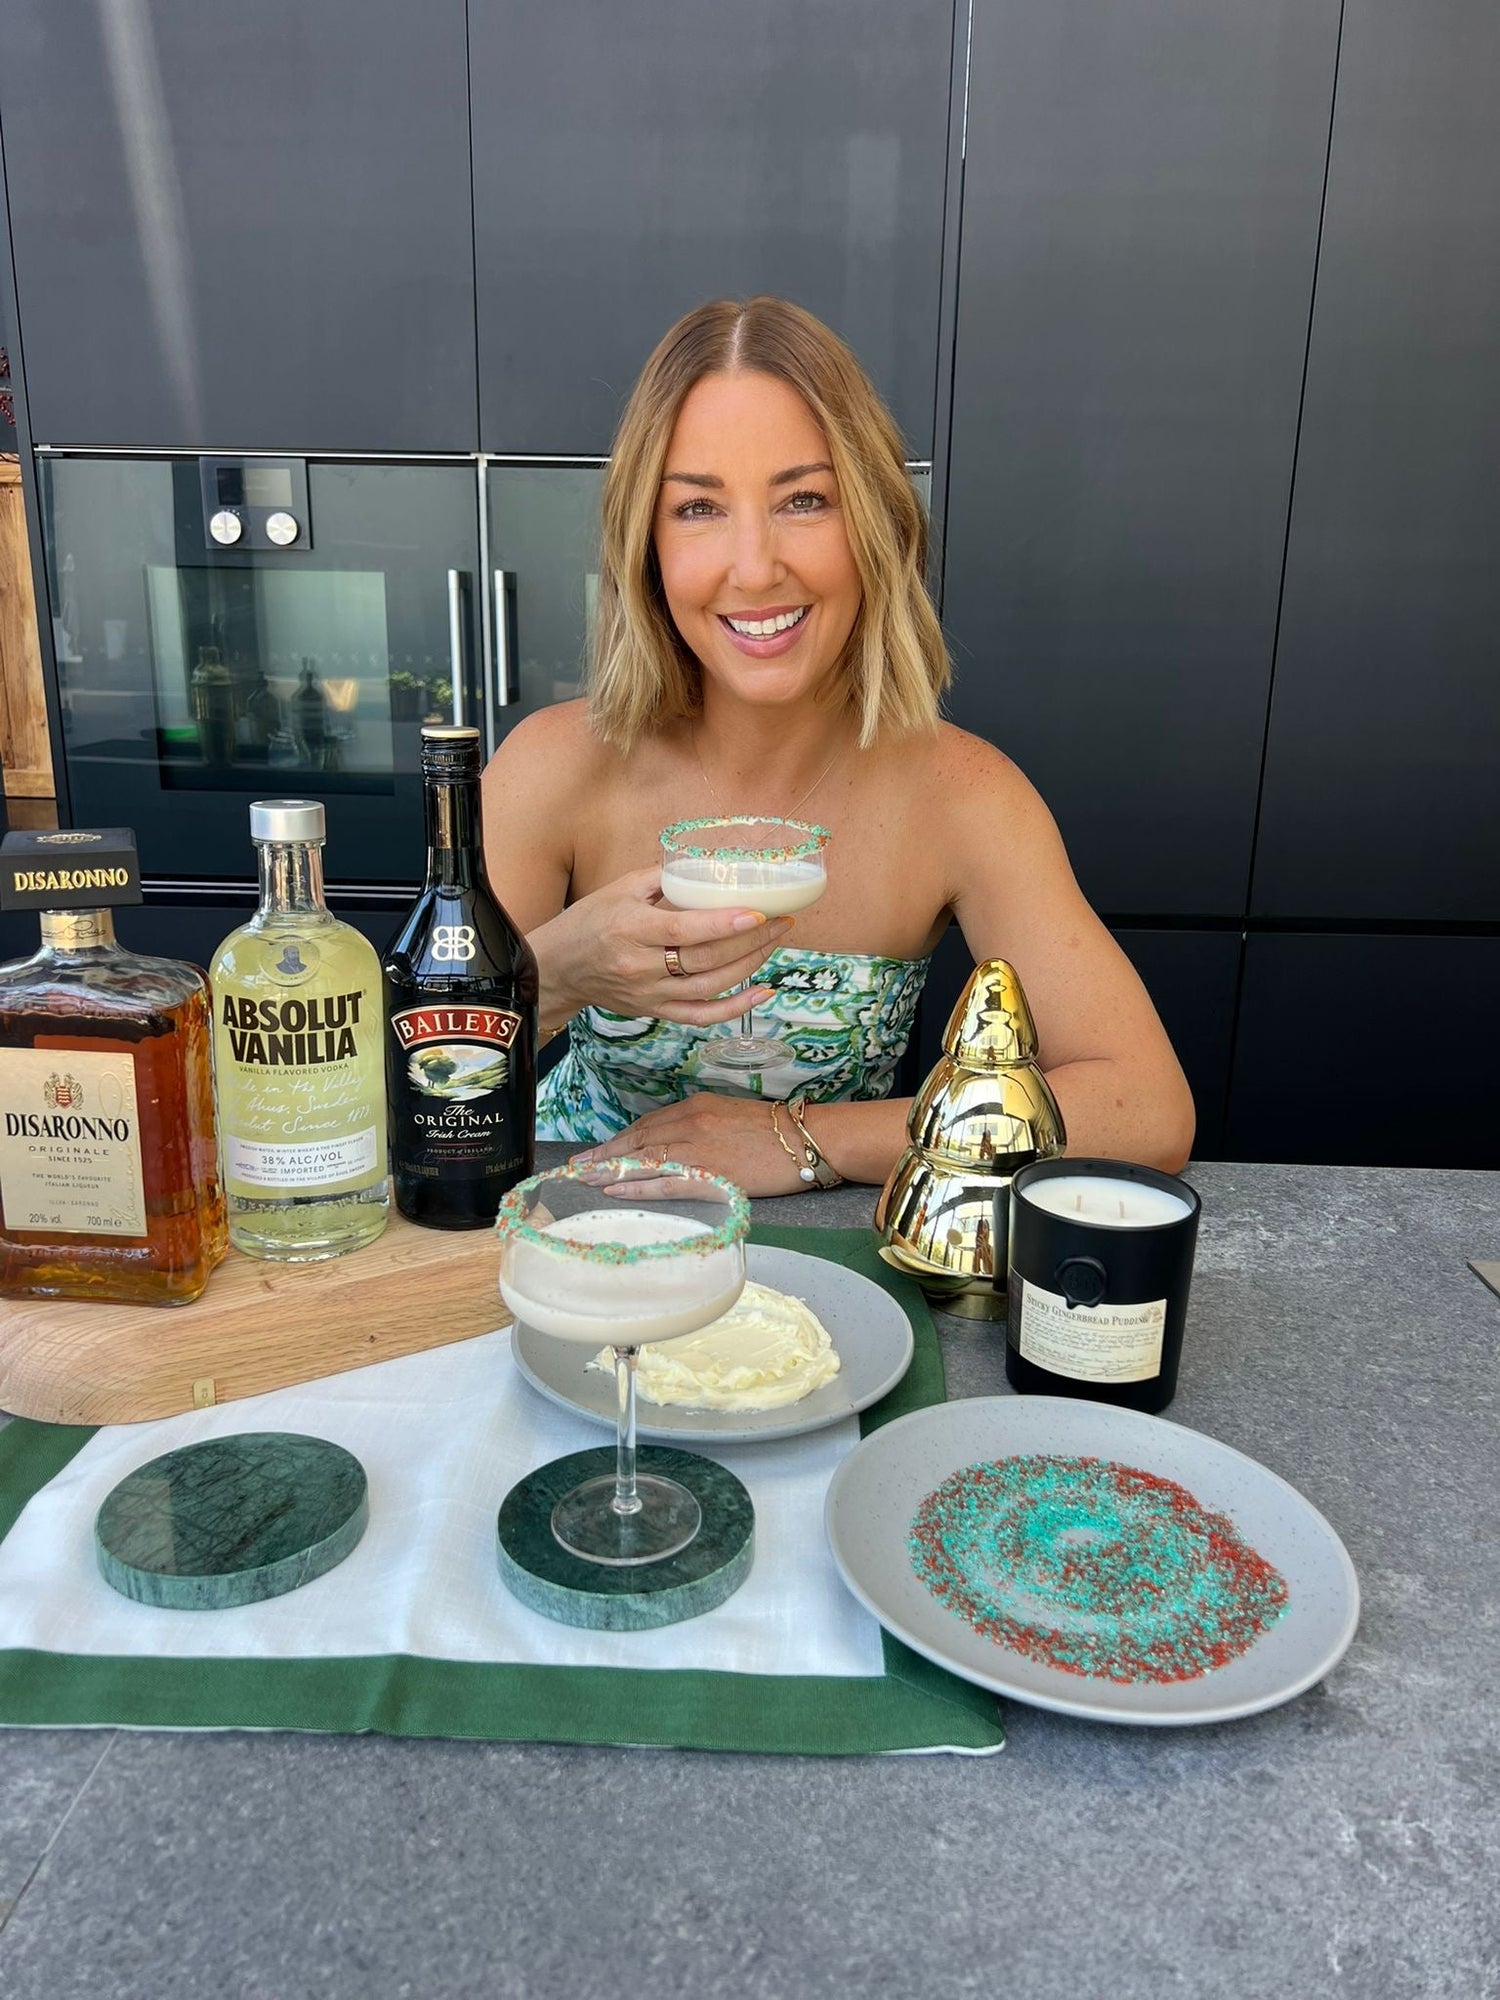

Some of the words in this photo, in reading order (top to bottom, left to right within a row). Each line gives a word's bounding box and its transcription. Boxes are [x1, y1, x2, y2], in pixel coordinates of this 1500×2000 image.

[13, 867, 129, 891] DISARONNO
[222, 990, 363, 1033] ABSOLUT
[399, 1012, 513, 1041] BAILEYS
[228, 1026, 358, 1066] VANILIA
[239, 1065, 270, 1076] VANILLA
[272, 1067, 319, 1077] FLAVORED
[320, 1062, 349, 1074] VODKA
[443, 1104, 475, 1117] The
[5, 1112, 130, 1142] DISARONNO
[414, 1112, 504, 1127] ORIGINAL
[425, 1129, 456, 1139] Irish
[456, 1129, 494, 1139] Cream
[28, 1145, 110, 1156] ORIGINALE
[48, 1155, 71, 1163] SINCE
[73, 1156, 93, 1164] 1525
[261, 1155, 285, 1166] 38%
[288, 1151, 343, 1166] ALC/VOL
[280, 1165, 325, 1175] IMPORTED
[29, 1213, 48, 1224] 20%
[87, 1215, 102, 1226] 700
[102, 1216, 113, 1227] ml
[1051, 1305, 1110, 1326] GINGERBREAD
